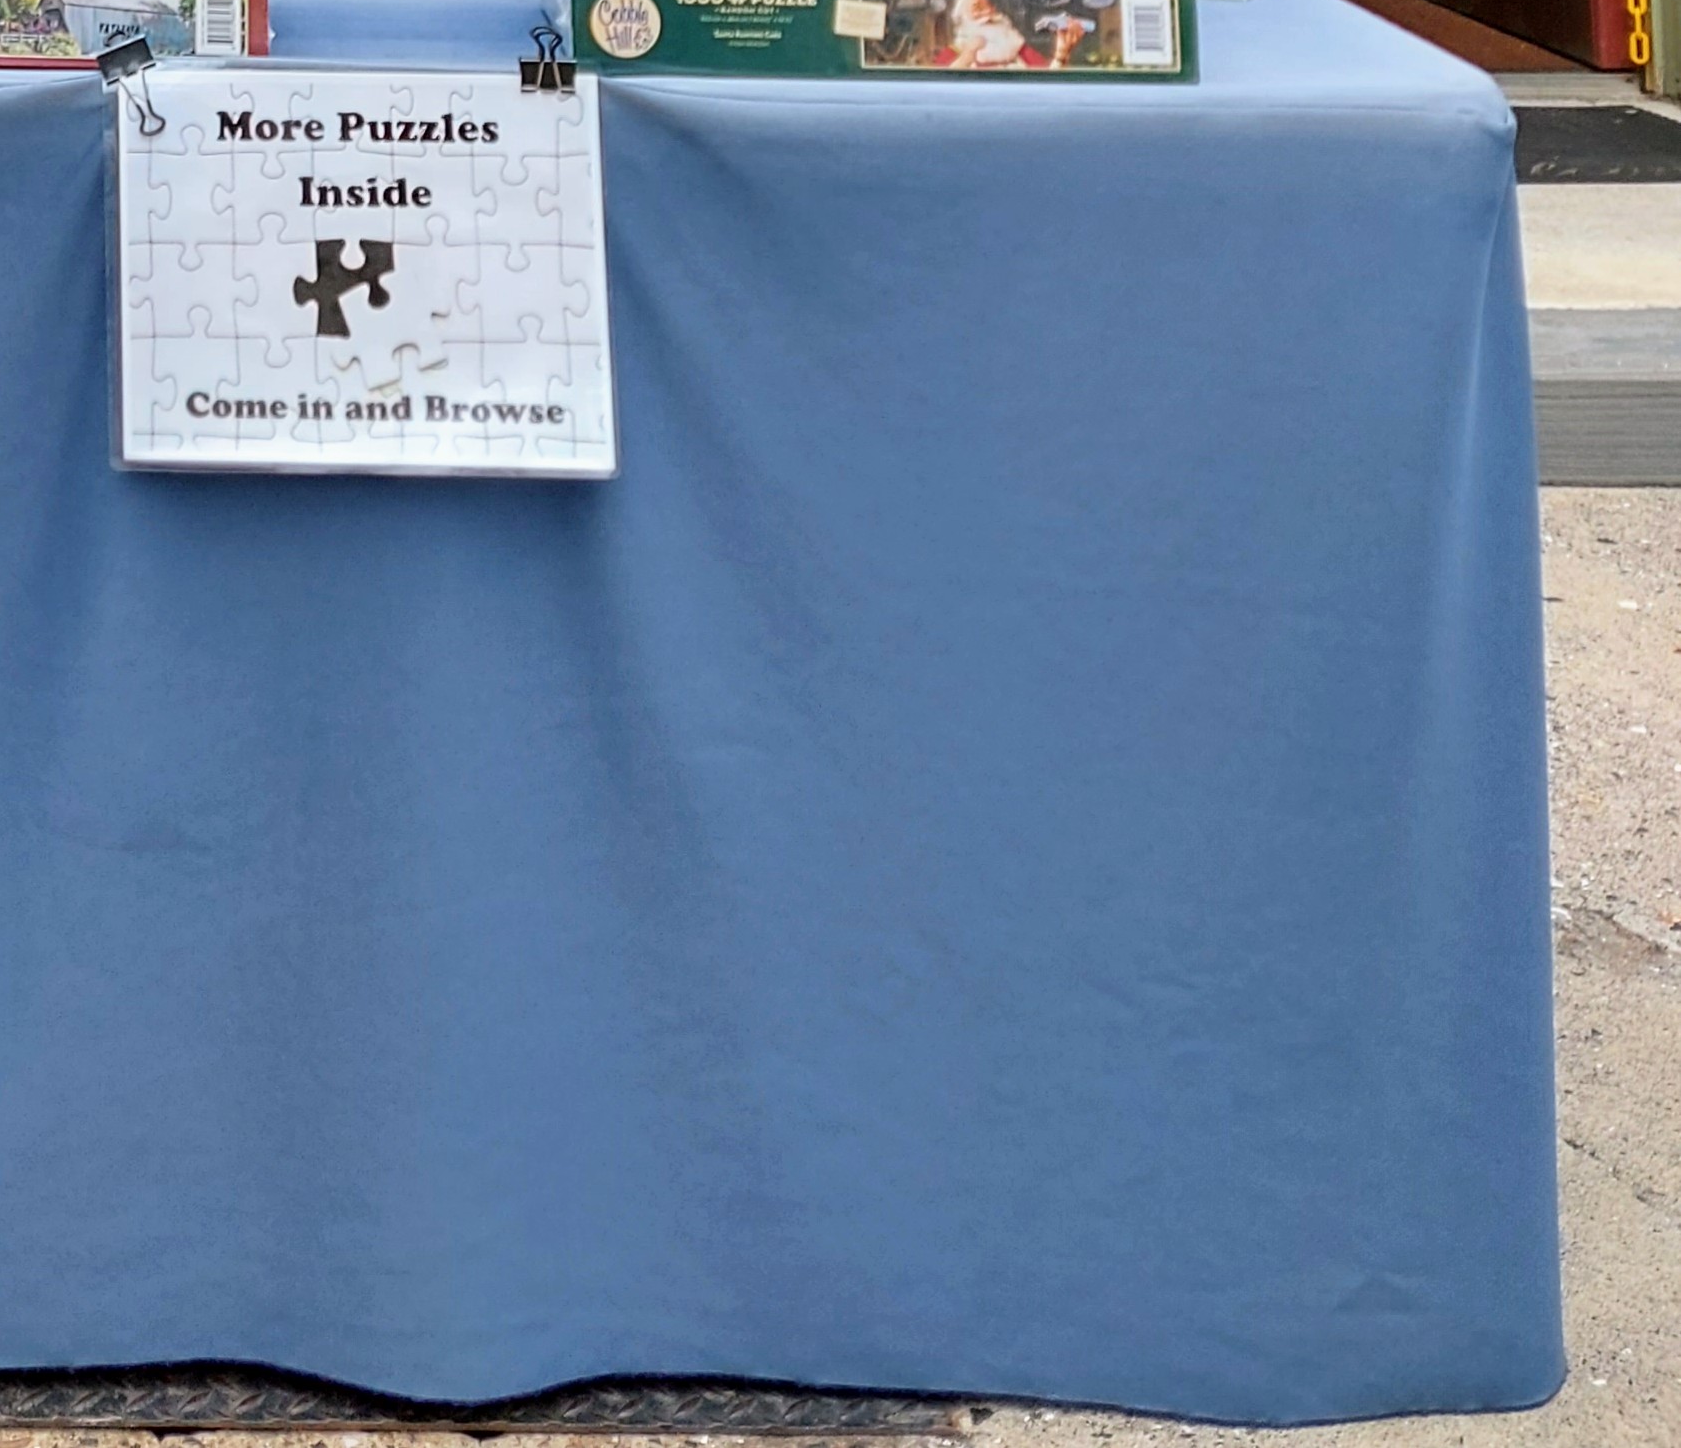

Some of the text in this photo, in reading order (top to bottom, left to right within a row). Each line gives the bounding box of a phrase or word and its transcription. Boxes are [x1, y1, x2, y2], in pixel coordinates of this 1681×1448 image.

[604, 25, 633, 54] Hill
[216, 110, 500, 144] More Puzzles
[298, 176, 433, 208] Inside
[185, 392, 566, 425] Come in and Browse
